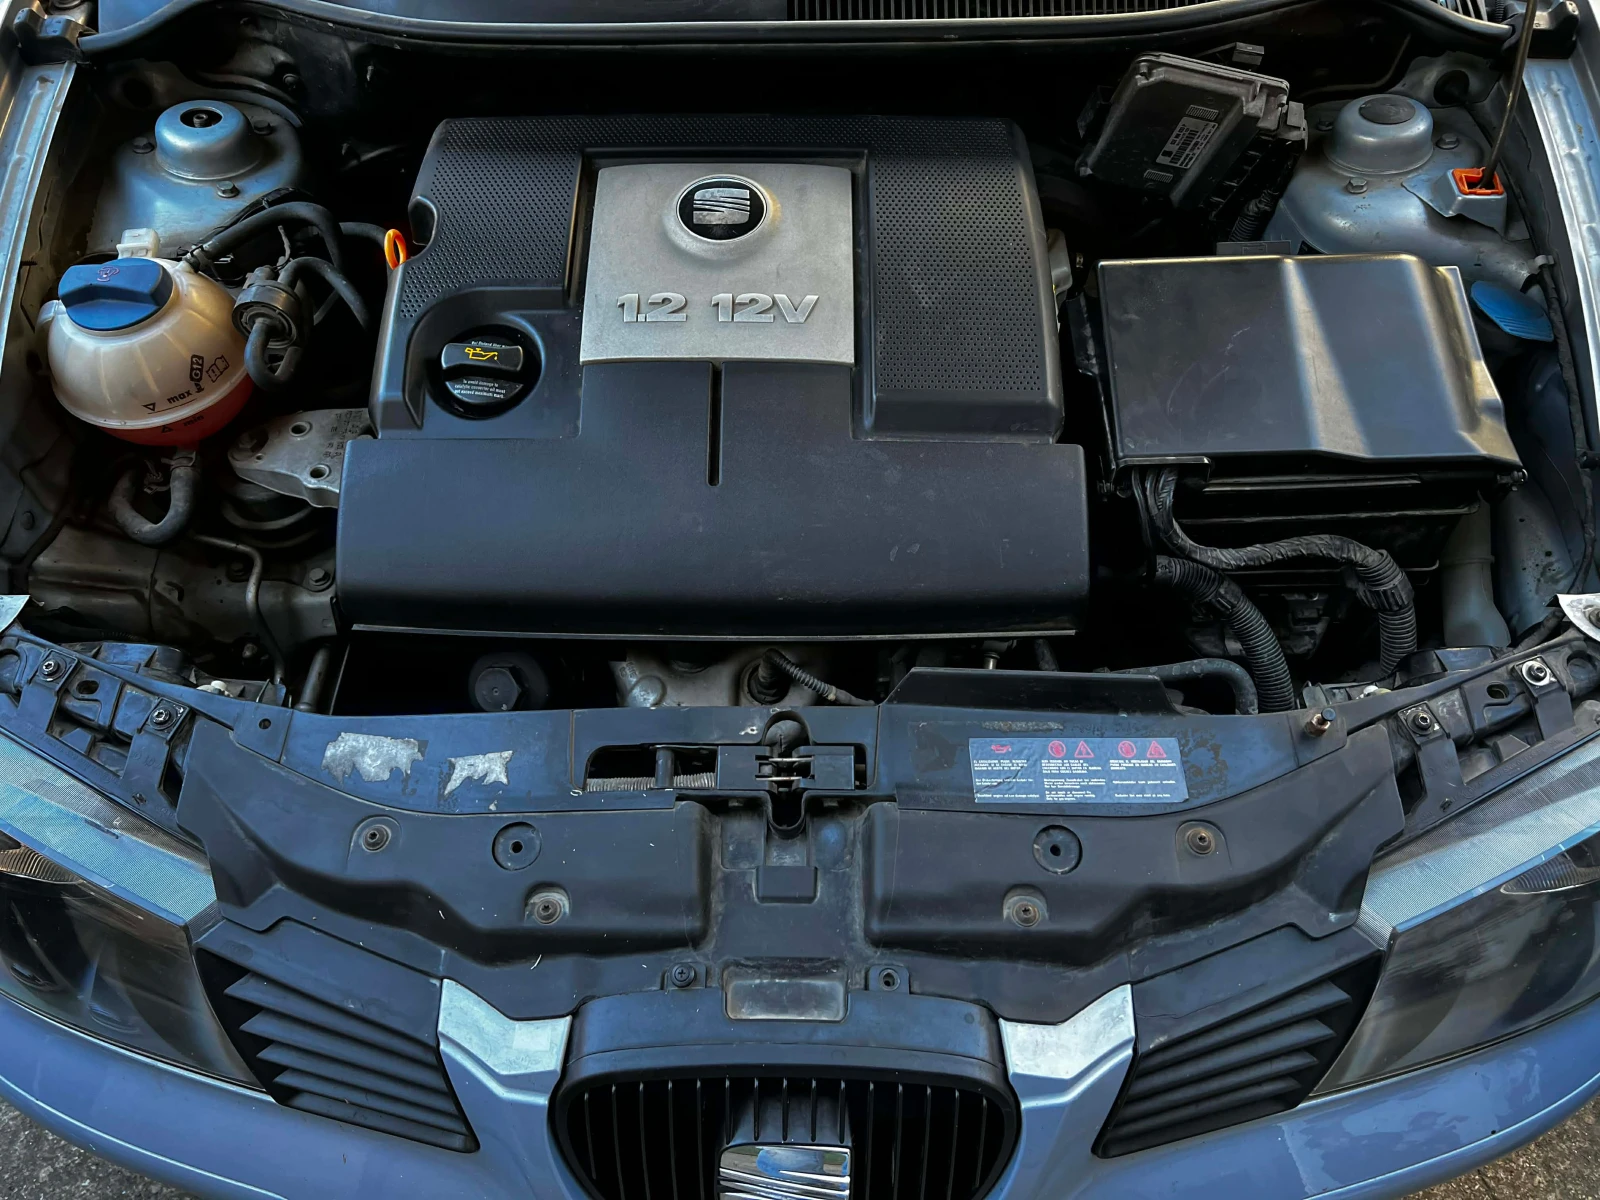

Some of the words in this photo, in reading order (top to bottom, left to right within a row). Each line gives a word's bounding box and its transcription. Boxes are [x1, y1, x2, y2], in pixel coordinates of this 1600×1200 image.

[617, 292, 688, 324] 1.2
[711, 292, 820, 324] 12V
[192, 357, 203, 379] G12
[167, 389, 193, 404] max
[183, 414, 205, 427] min
